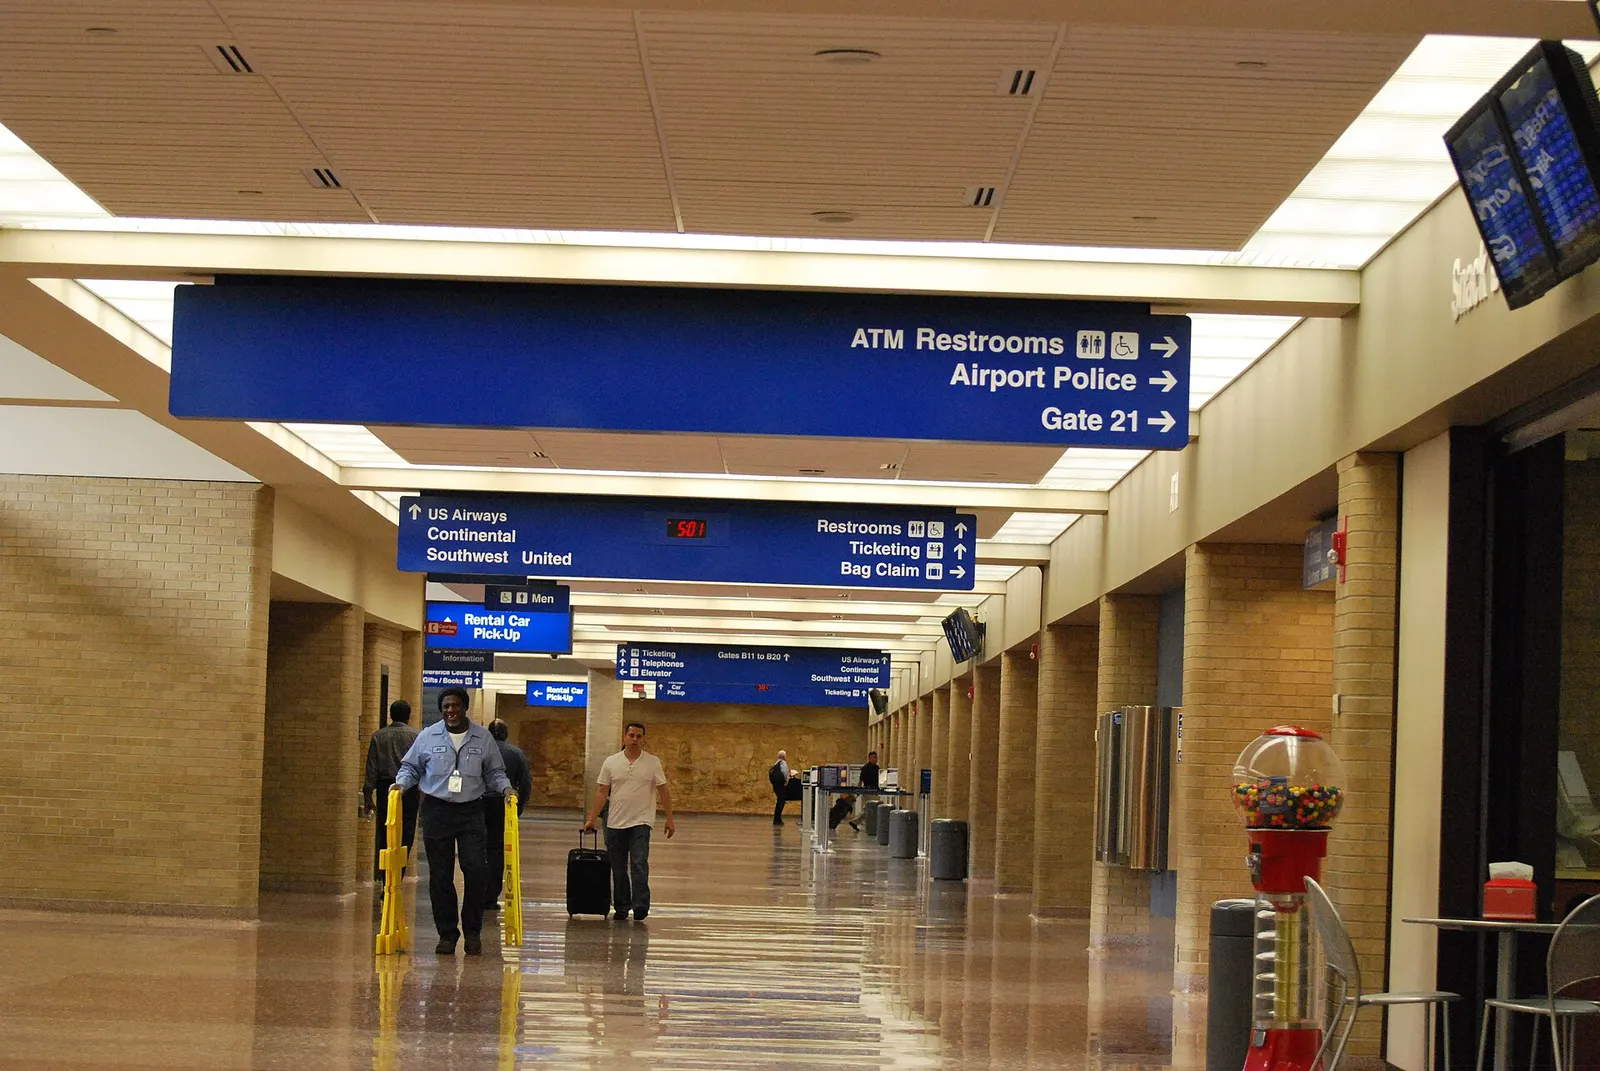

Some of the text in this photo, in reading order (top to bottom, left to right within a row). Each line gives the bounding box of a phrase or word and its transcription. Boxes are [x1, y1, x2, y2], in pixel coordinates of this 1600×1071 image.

[851, 327, 1064, 355] ATM Restrooms
[949, 362, 1137, 393] Airport Police
[1041, 406, 1138, 432] Gate 21
[428, 508, 508, 523] US Airways
[817, 519, 902, 536] Restrooms
[427, 526, 516, 543] Continental
[849, 540, 921, 560] Ticketing
[426, 547, 572, 566] Southwest United
[840, 561, 920, 579] Bag Claim
[531, 593, 554, 604] Men
[464, 613, 530, 627] Rental Car
[474, 627, 520, 643] Pick-Up
[442, 654, 485, 662] Information
[641, 649, 676, 660] Ticketing
[717, 651, 740, 660] Gates
[741, 652, 755, 660] B11
[766, 652, 782, 661] B20
[641, 659, 685, 669] Telephones
[841, 656, 880, 666] US Airways
[640, 668, 673, 678] Elevator
[840, 665, 880, 674] Continental
[810, 673, 879, 684] Southwest United
[546, 686, 570, 694] Rental
[824, 688, 852, 698] Ticketing
